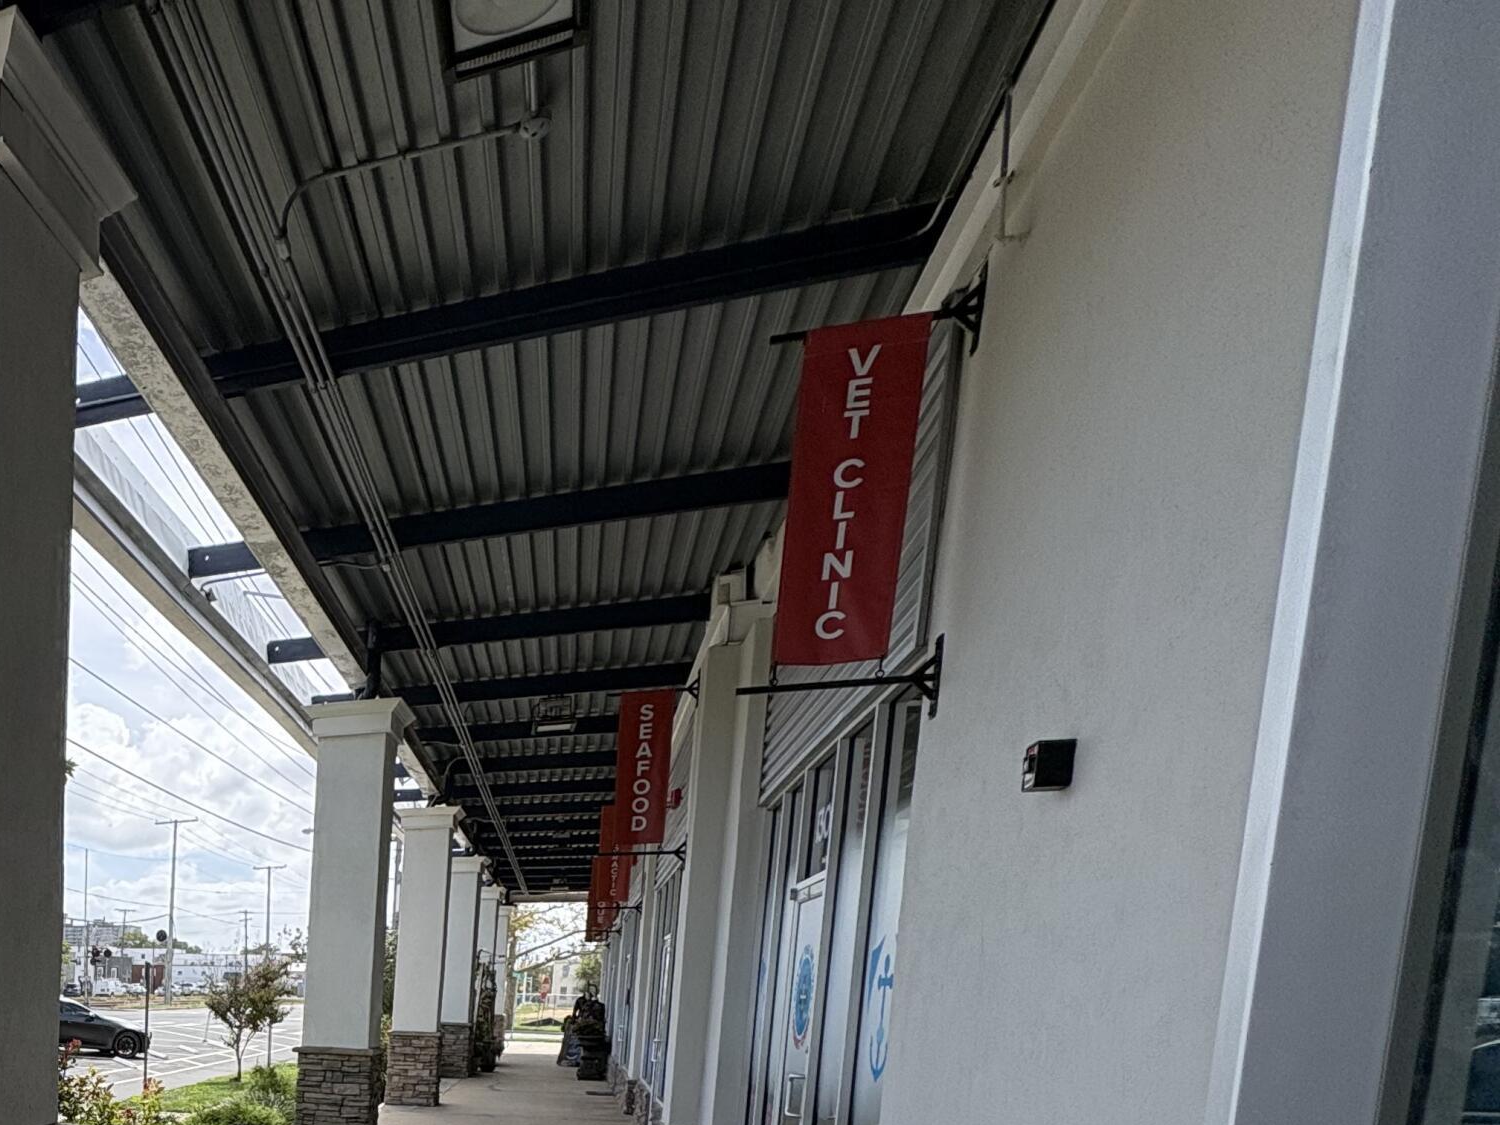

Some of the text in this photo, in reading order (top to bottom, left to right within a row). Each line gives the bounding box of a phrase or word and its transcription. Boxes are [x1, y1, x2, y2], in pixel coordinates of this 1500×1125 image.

[815, 344, 881, 640] VET CLINIC
[631, 704, 654, 831] SEAFOOD
